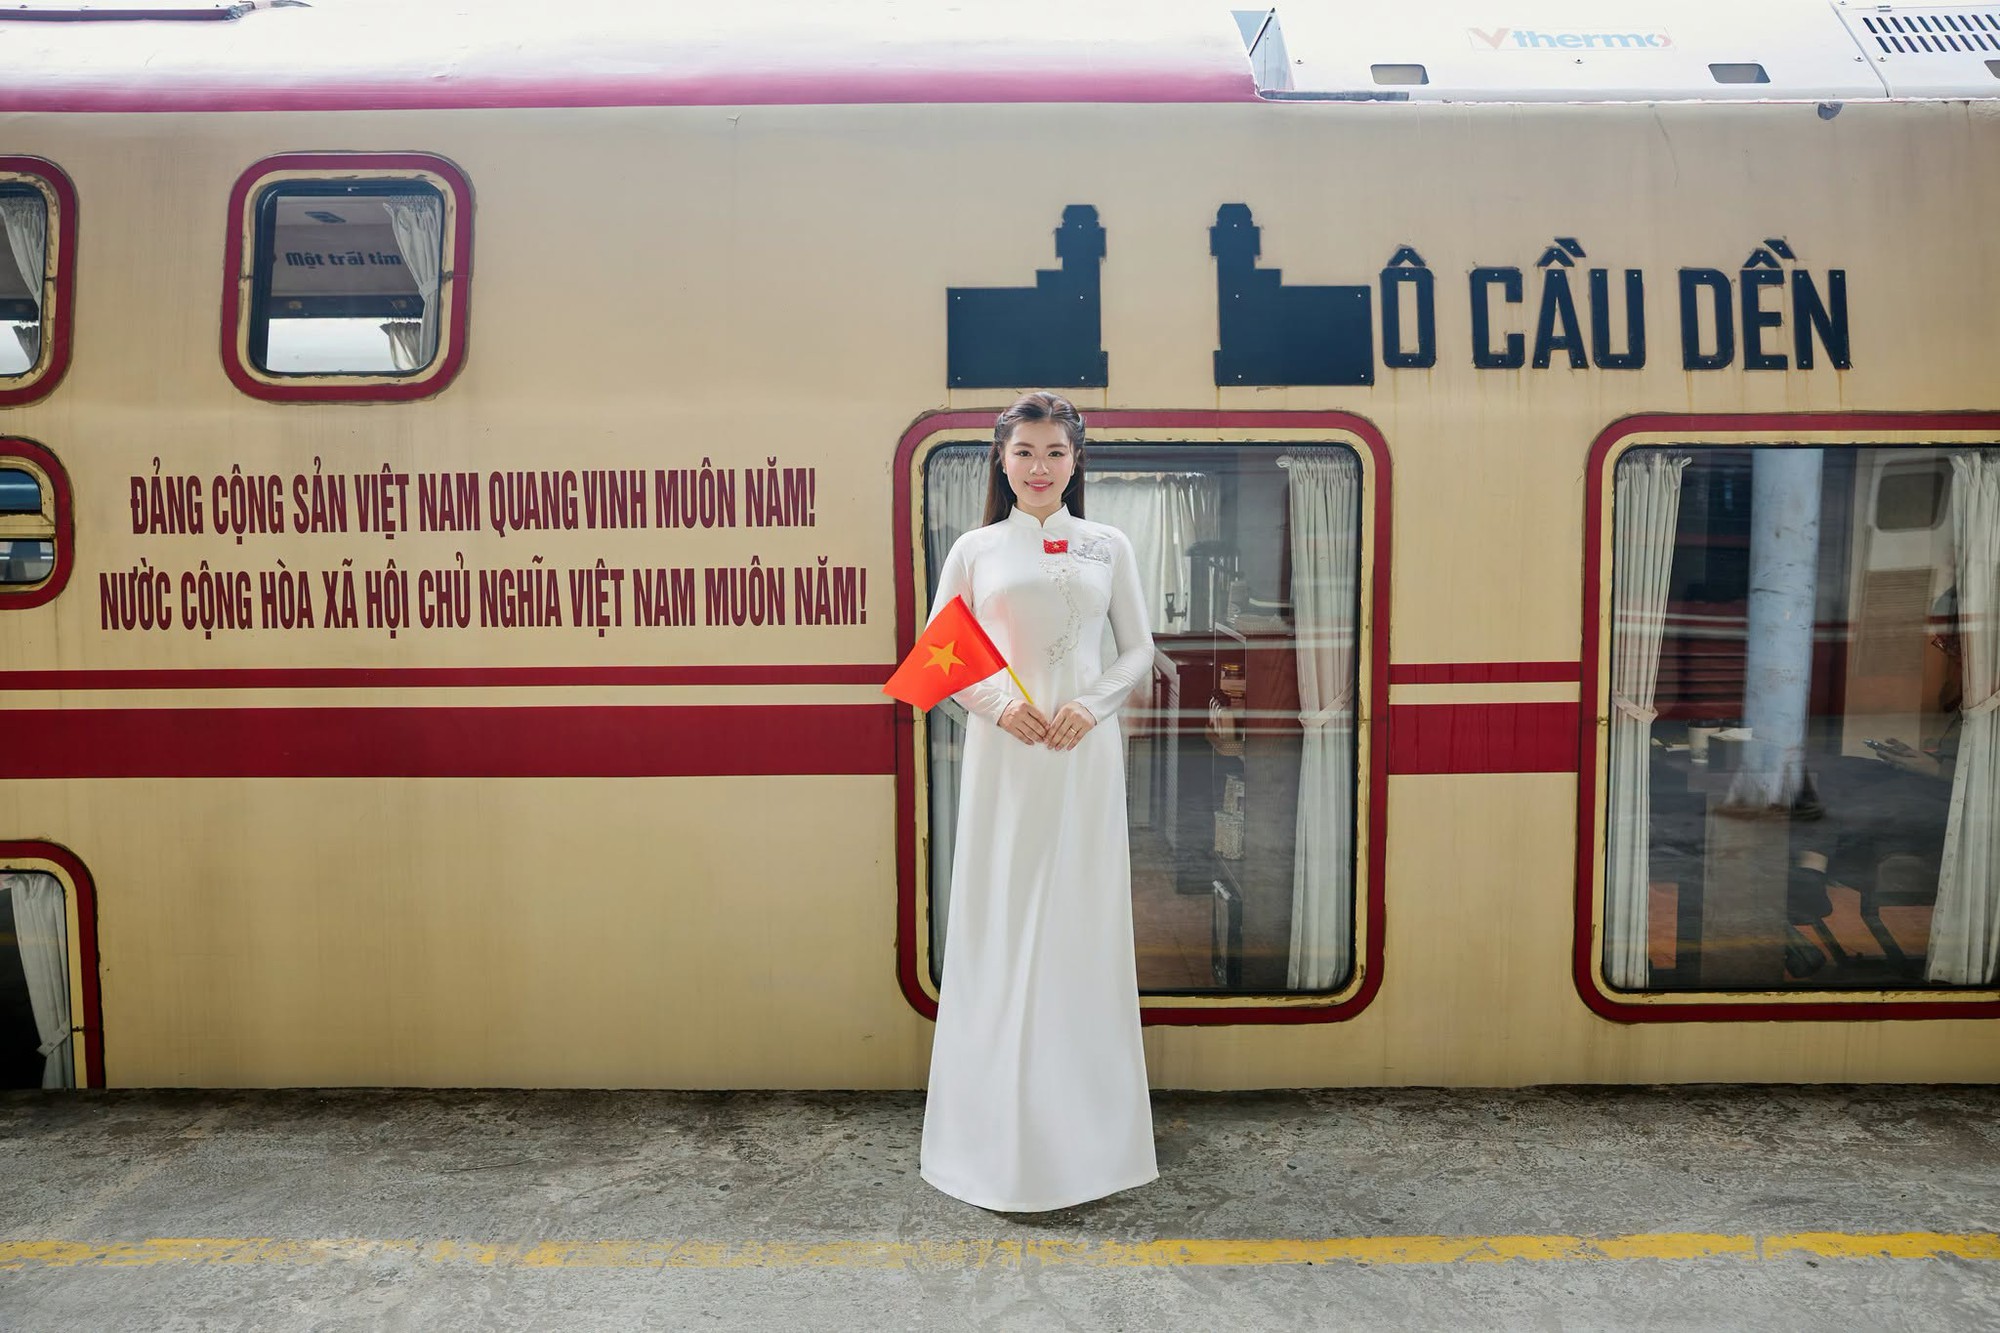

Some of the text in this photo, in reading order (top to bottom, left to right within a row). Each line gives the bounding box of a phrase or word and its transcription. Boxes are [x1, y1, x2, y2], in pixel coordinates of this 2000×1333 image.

[285, 251, 325, 269] Một
[328, 251, 365, 266] trái
[1380, 238, 1851, 372] Ô CẦU DỀN
[130, 455, 816, 546] ĐẢNG CỘNG SẢN VIỆT NAM QUANG VINH MUÔN NĂM!
[180, 559, 253, 641] CỘNG
[259, 559, 315, 630] HÒA
[321, 558, 359, 629] XÃ
[365, 558, 410, 640] HỘI
[418, 551, 471, 629] CHỦ
[478, 555, 563, 629] NGHĨA
[568, 558, 625, 638] VIỆT
[632, 568, 696, 627] NAM
[704, 555, 786, 627] MUÔN
[794, 555, 867, 626] NĂM!
